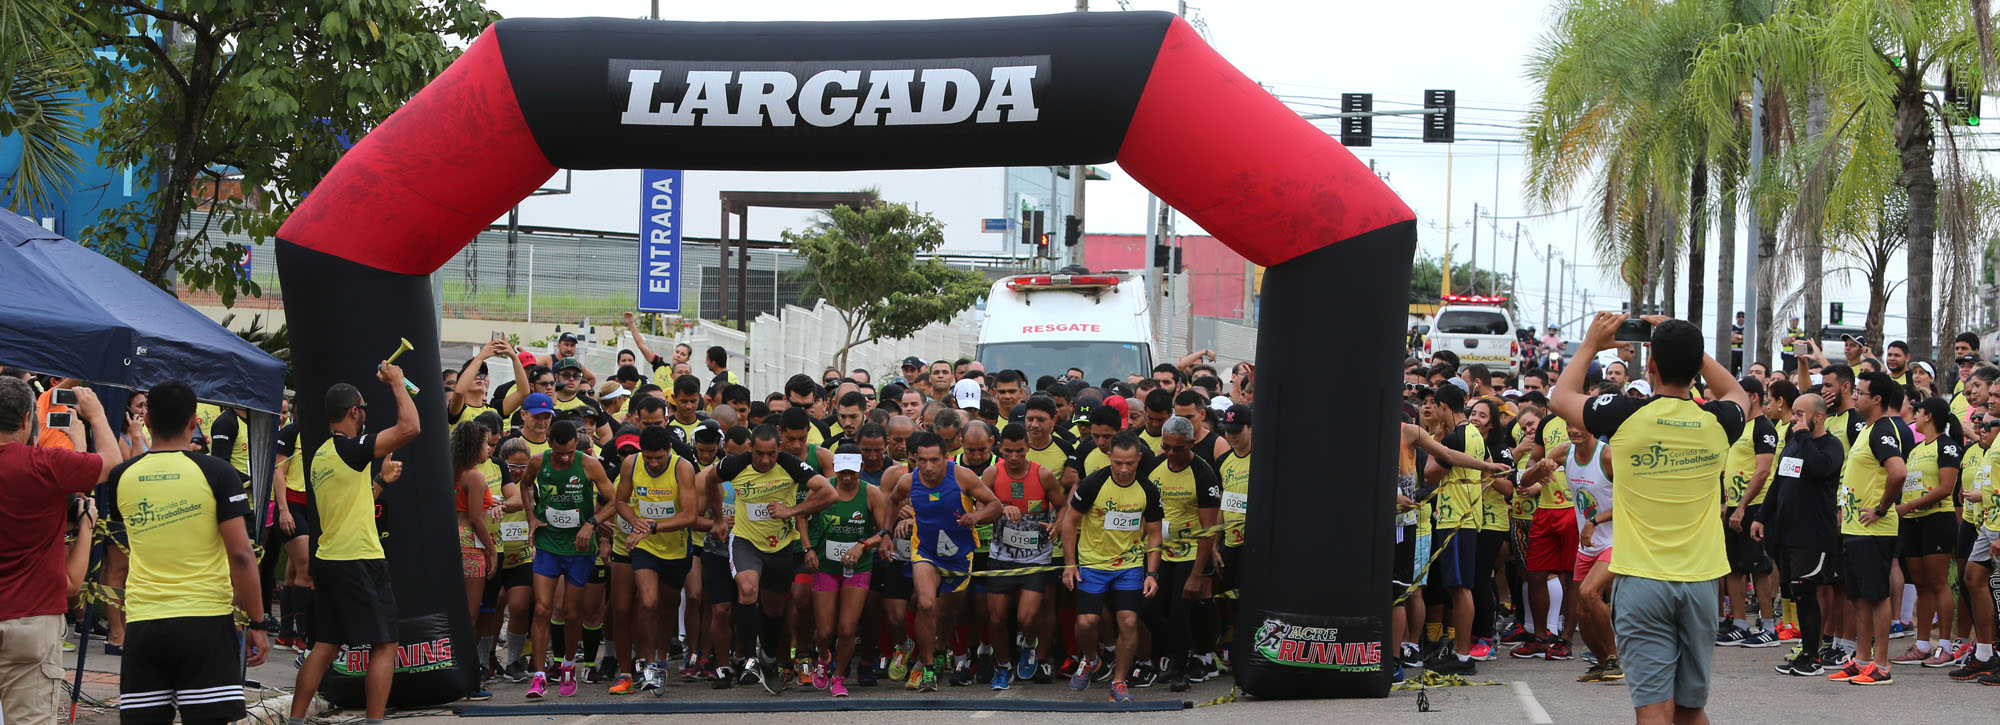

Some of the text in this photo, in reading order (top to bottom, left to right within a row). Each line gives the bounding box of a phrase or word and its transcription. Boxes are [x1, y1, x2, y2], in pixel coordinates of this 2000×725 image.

[620, 65, 1040, 127] LARGADA
[649, 177, 673, 293] ENTRADA
[1022, 323, 1101, 334] RESGATE
[1669, 449, 1697, 459] Corrida
[1669, 452, 1720, 467] Trabalhador
[155, 501, 178, 513] Corrida
[1226, 499, 1242, 508] 026
[156, 503, 202, 521] Trabalhador
[647, 507, 666, 515] 017
[755, 509, 768, 517] 06
[552, 514, 572, 524] 362
[1113, 517, 1132, 526] 021
[506, 527, 523, 537] 279
[1010, 535, 1030, 545] 019
[833, 548, 846, 557] 36
[1288, 625, 1338, 641] ACRE
[347, 638, 452, 672] RNING
[1277, 640, 1381, 665] RUNNING
[409, 660, 453, 673] EVENTOS
[1340, 664, 1381, 672] EVENTOS
